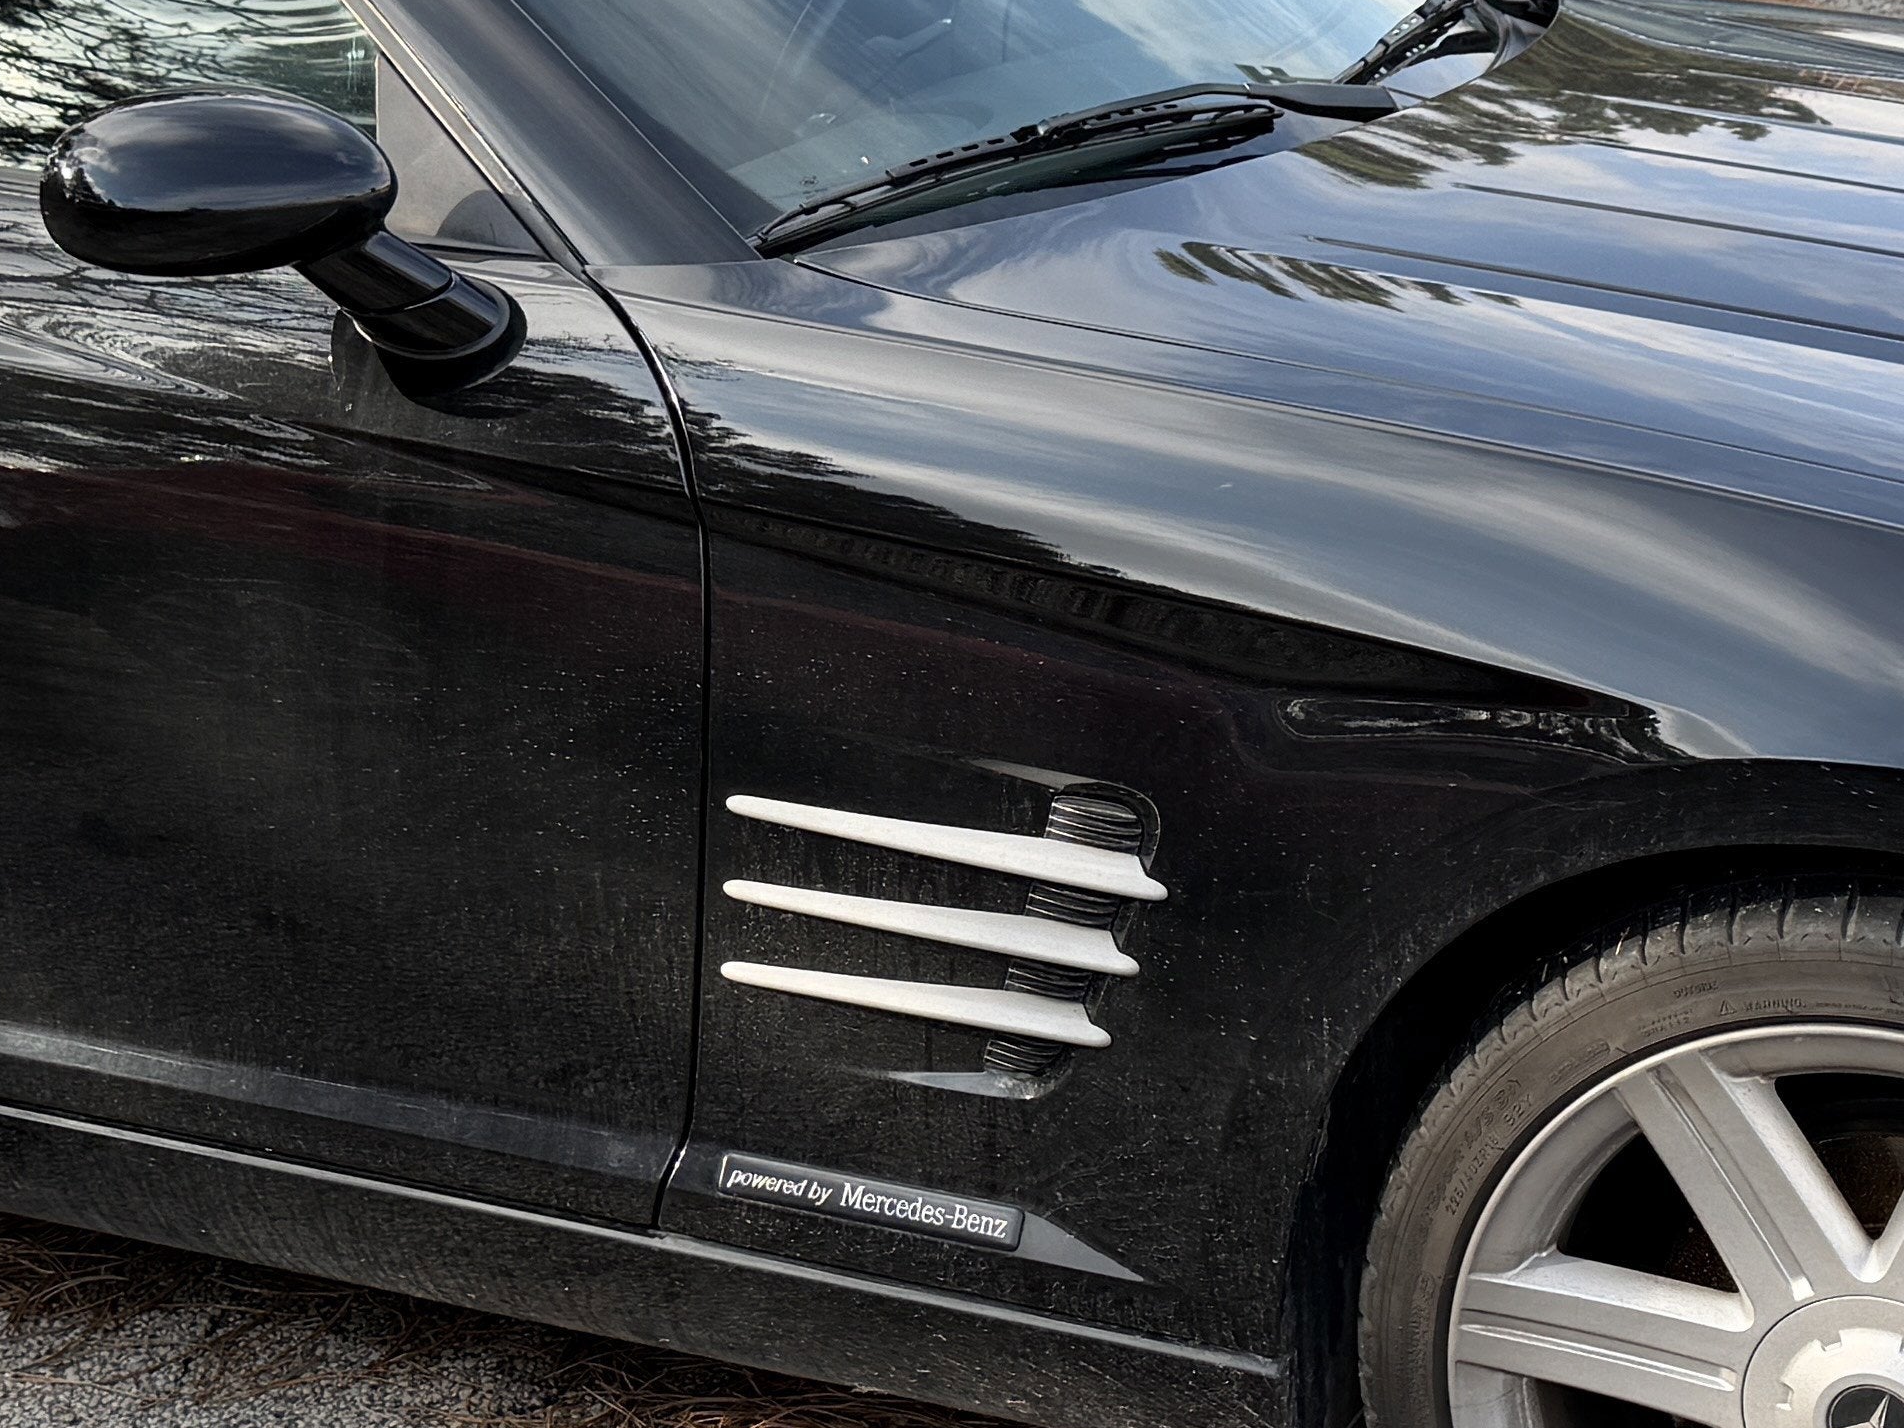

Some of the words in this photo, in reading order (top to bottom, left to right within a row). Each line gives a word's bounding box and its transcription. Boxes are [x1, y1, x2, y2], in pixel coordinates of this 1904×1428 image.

[727, 1169, 807, 1196] powered
[807, 1181, 833, 1206] by
[839, 1182, 1008, 1239] Mercedes-Benz
